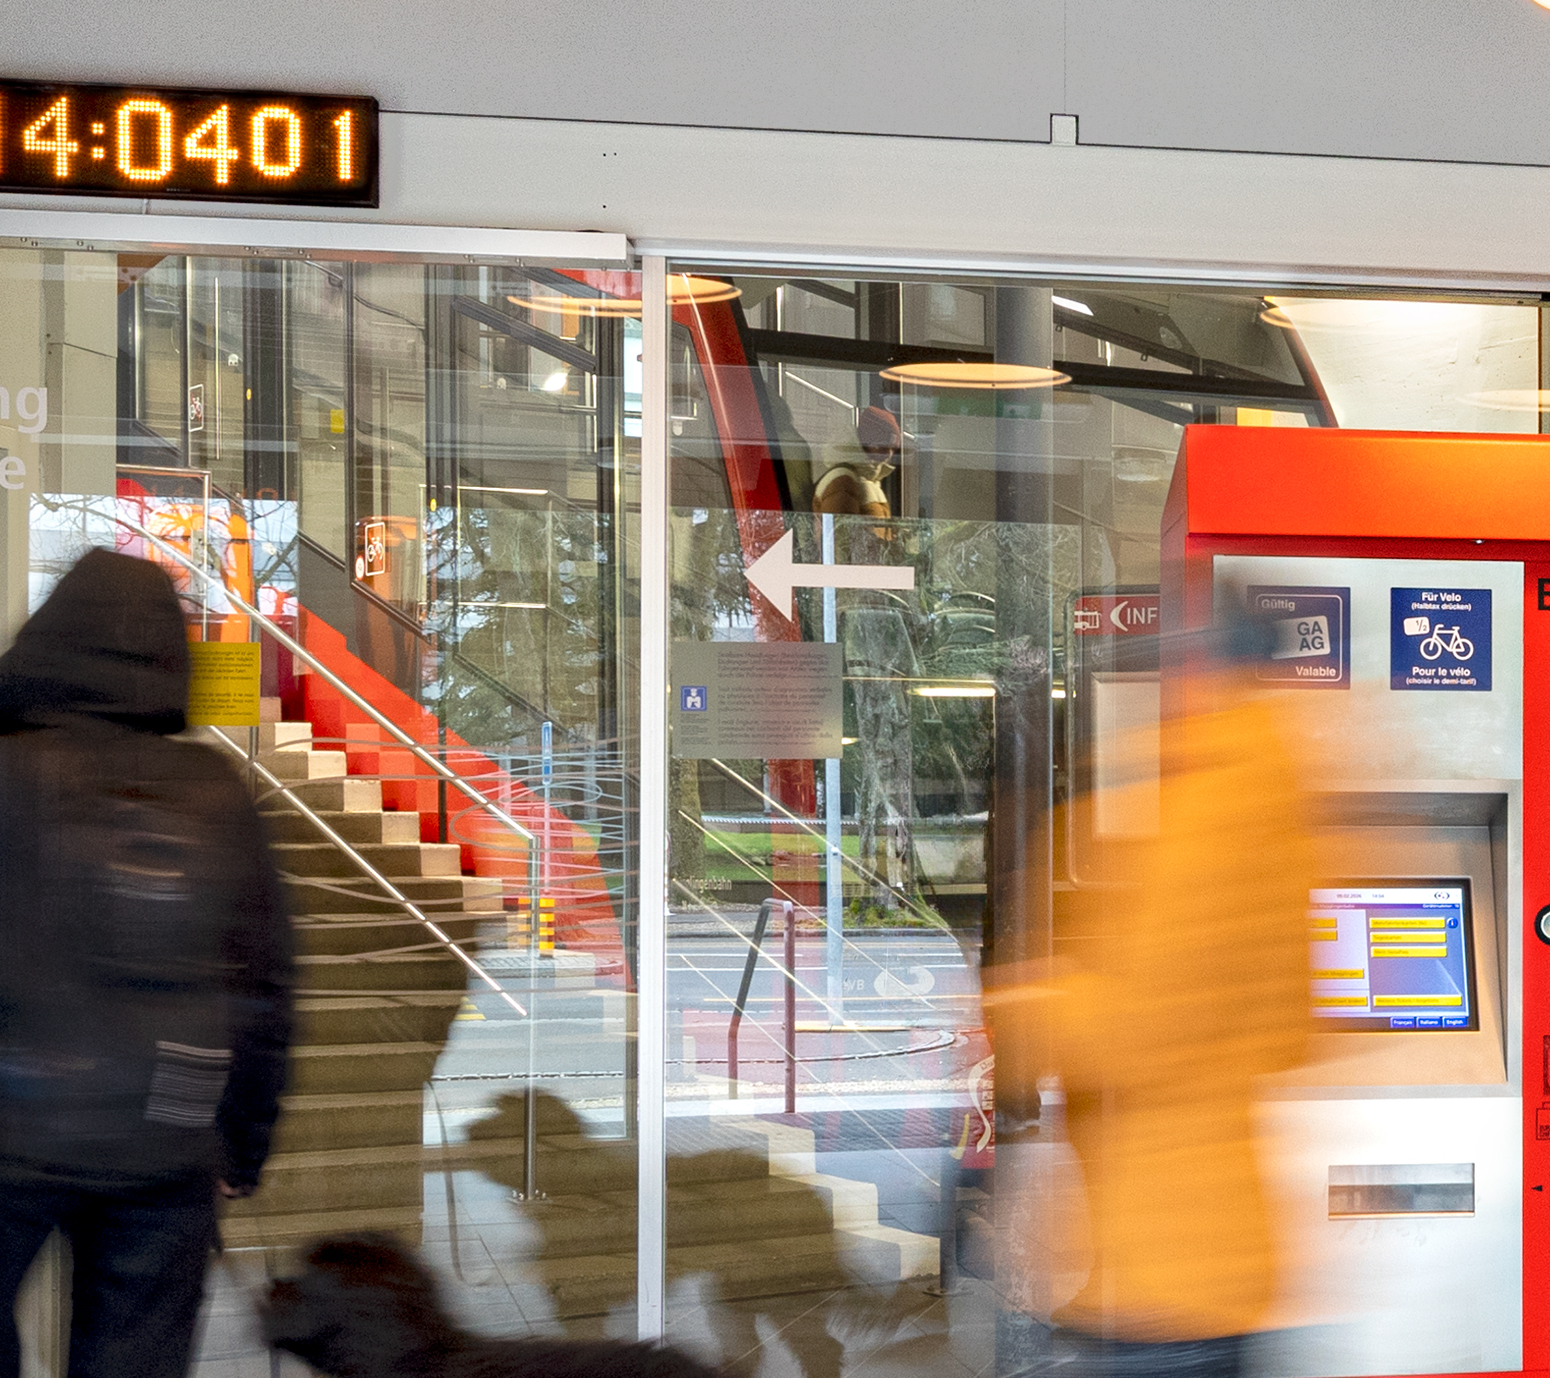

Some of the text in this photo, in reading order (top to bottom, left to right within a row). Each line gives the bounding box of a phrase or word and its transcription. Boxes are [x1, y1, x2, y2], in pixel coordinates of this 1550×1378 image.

[1422, 591, 1461, 602] Für Velo
[1261, 598, 1296, 612] Gültig
[1126, 607, 1158, 625] INF
[1297, 621, 1323, 635] GA
[1299, 636, 1325, 651] AG
[1296, 666, 1336, 677] Valable
[1412, 666, 1470, 676] Pour le vélo
